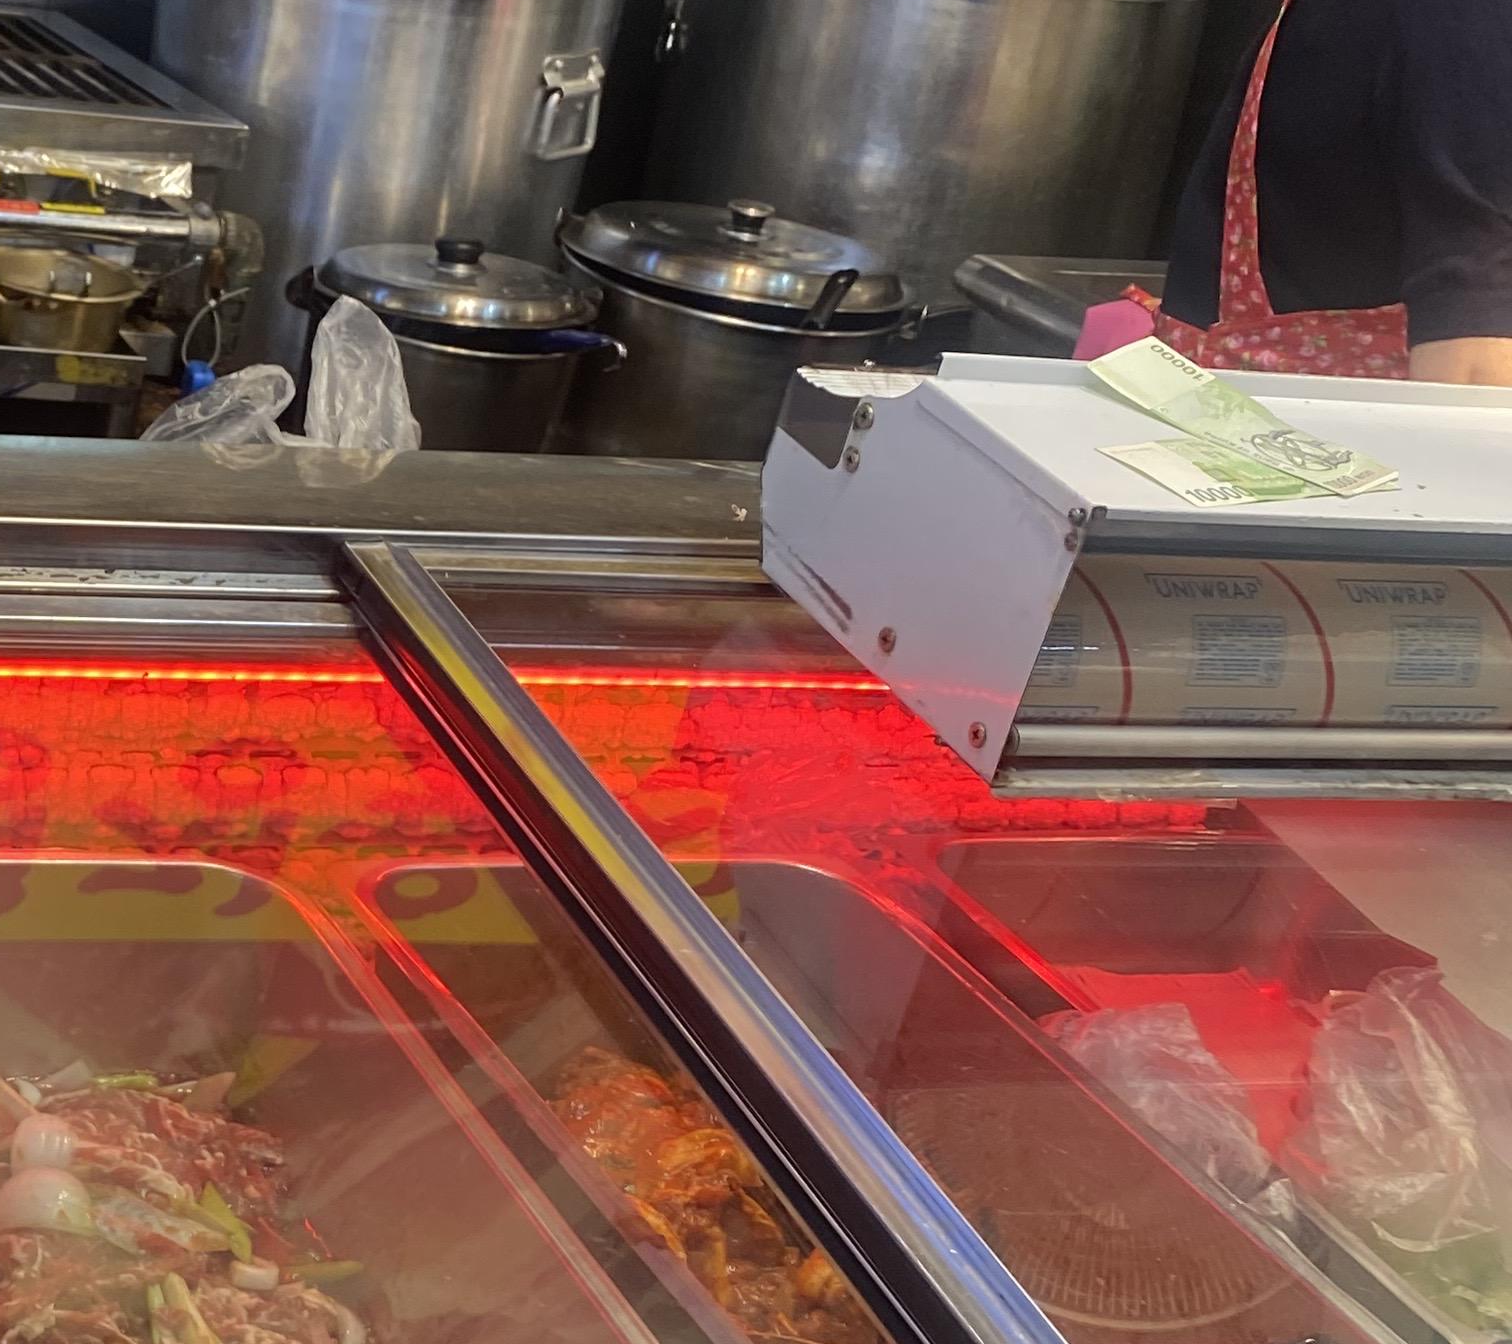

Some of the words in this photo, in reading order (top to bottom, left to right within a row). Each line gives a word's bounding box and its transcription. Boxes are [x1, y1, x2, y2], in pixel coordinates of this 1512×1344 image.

[1149, 343, 1209, 382] 10000
[1184, 484, 1256, 504] 10000
[1151, 578, 1260, 601] UNIWRAP
[1346, 583, 1449, 605] UNIWRAP
